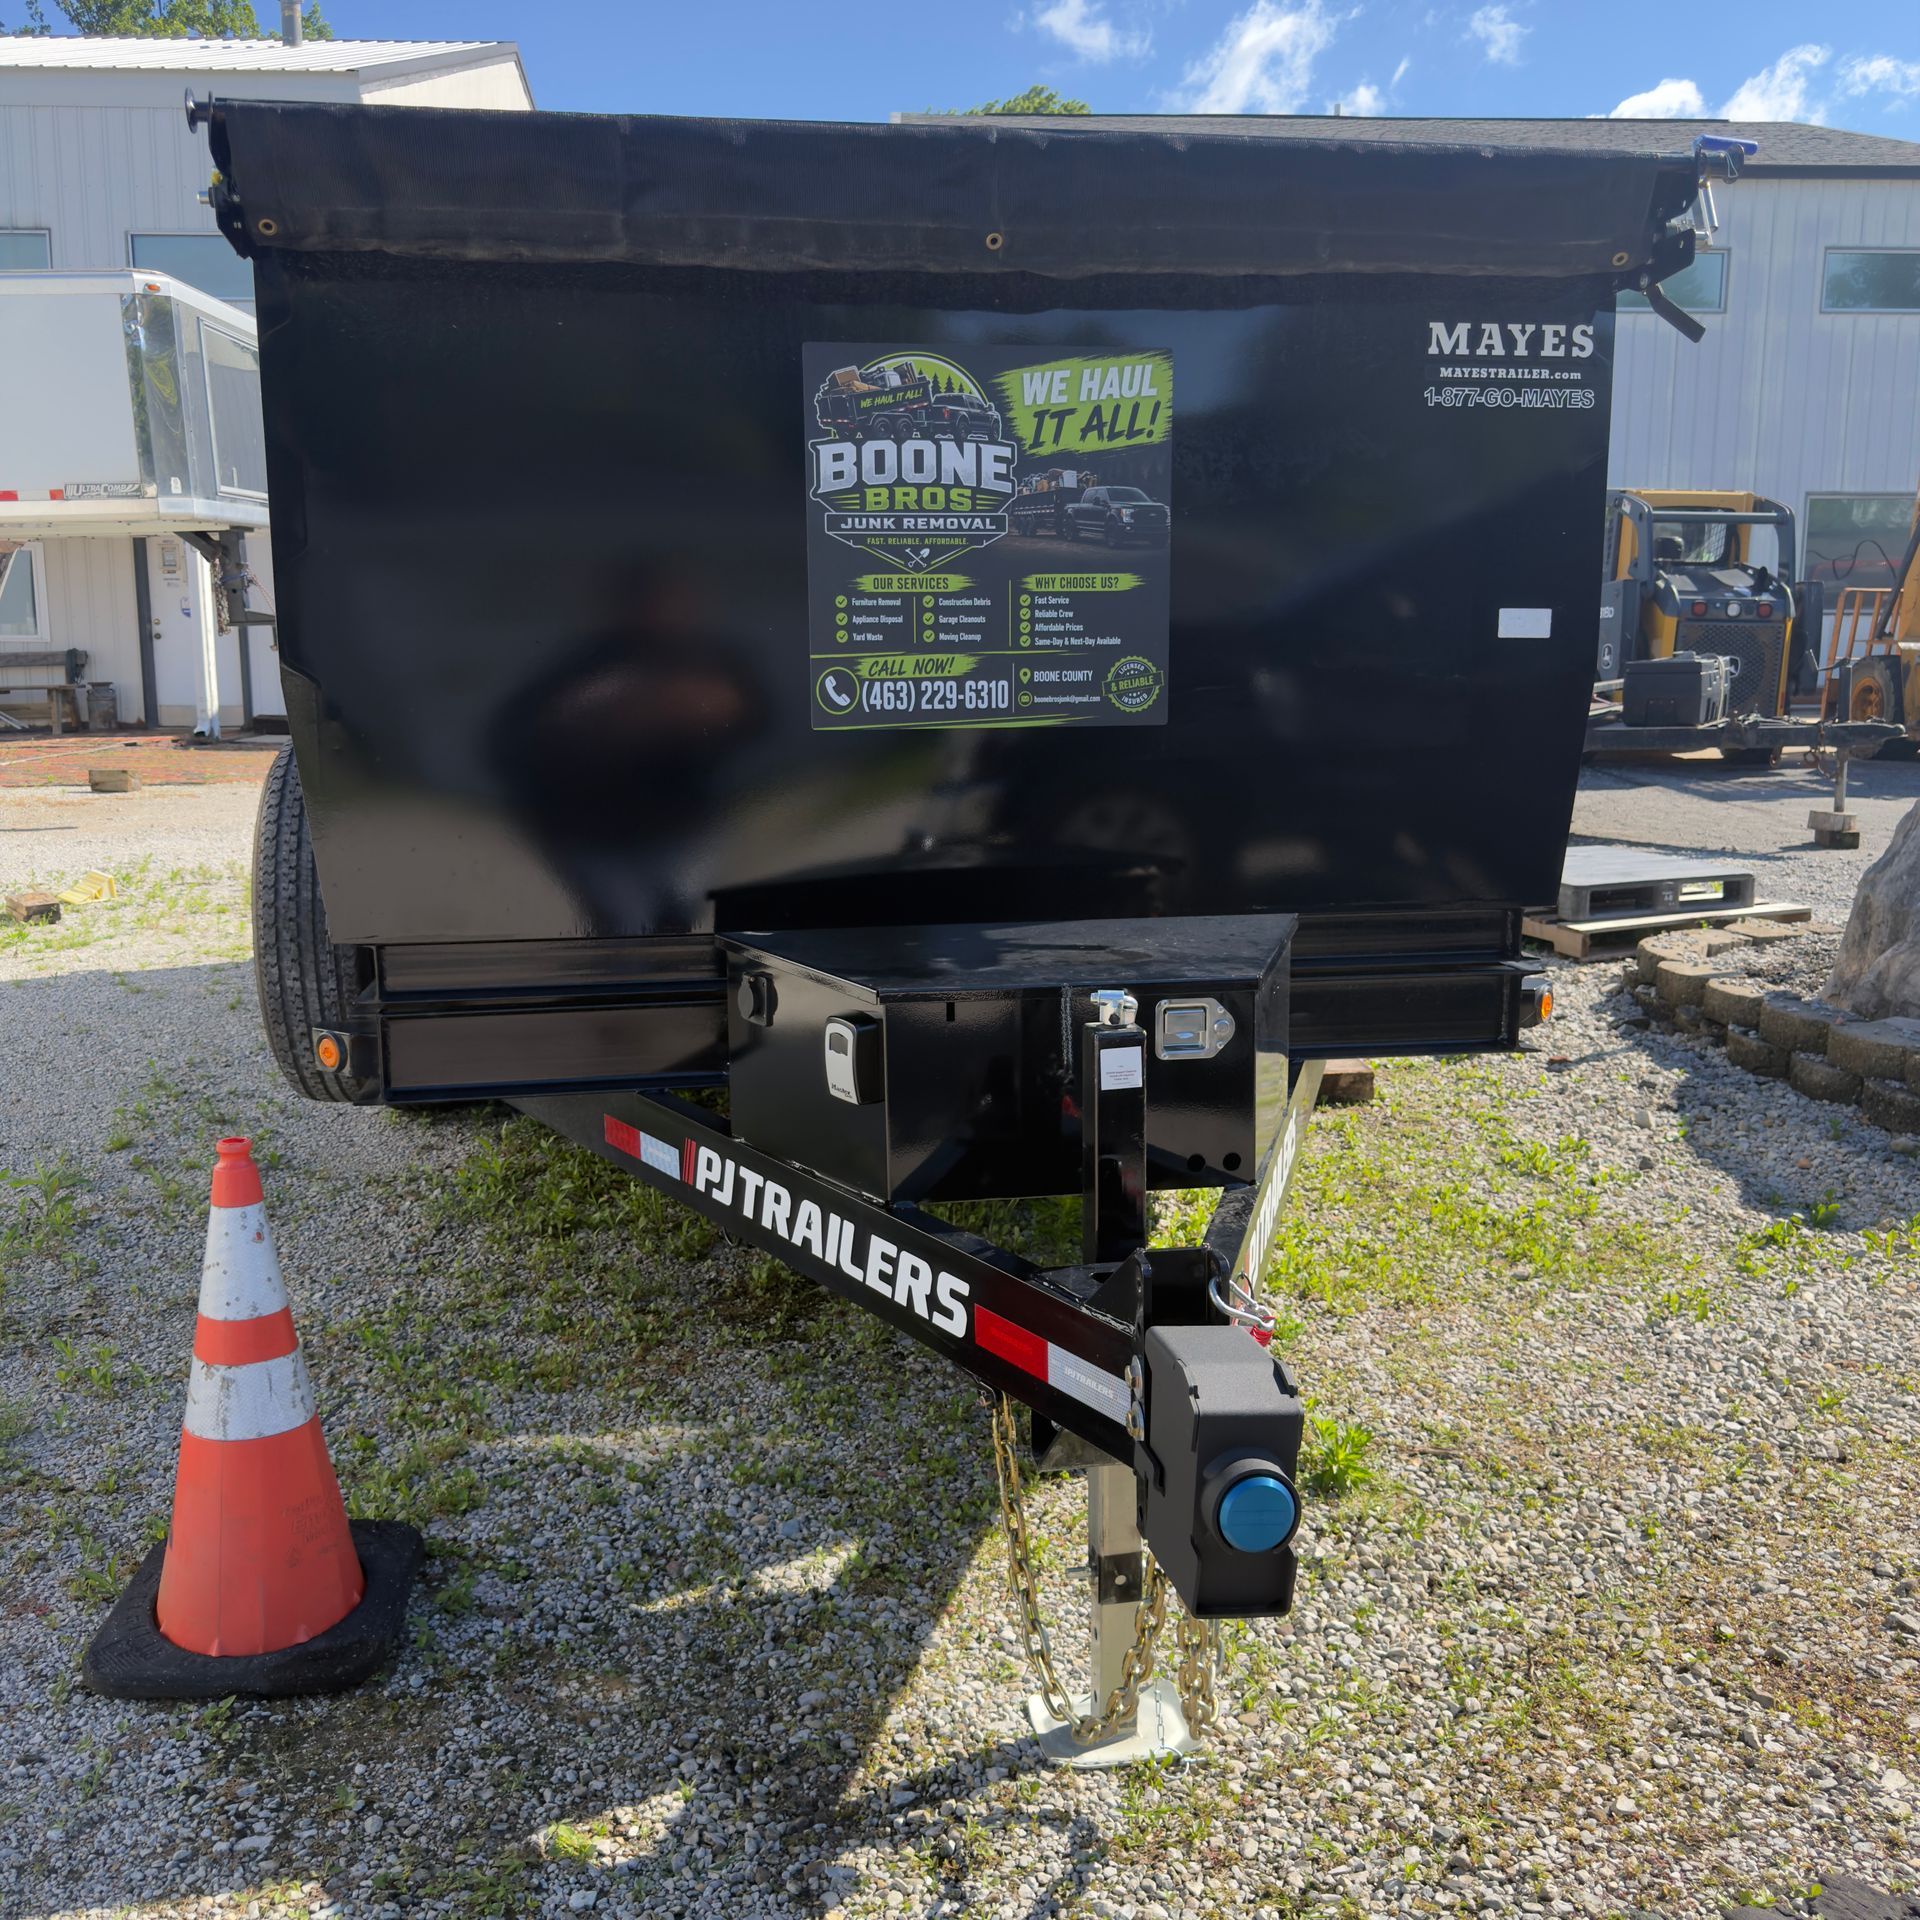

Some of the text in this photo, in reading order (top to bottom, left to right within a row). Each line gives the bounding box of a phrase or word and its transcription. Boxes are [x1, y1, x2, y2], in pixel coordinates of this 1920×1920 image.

[1427, 321, 1594, 358] MAYES
[1439, 367, 1582, 380] MAYESTRAILER.com
[1022, 364, 1158, 406] WE HAUL
[859, 389, 924, 409] WE HAUL IT ALL!
[1424, 386, 1595, 409] 1-877-GO-MAYES
[1028, 400, 1162, 450] IT ALL!
[816, 439, 1013, 494] BOONE
[863, 486, 973, 512] BROS
[840, 517, 997, 530] JUNK REMOVAL
[867, 537, 969, 545] FAST. RELIABLE. AFFORDABLE.
[873, 577, 949, 590] OUR SERVICES
[1035, 576, 1119, 589] WHY CHOOSE US?
[852, 598, 901, 606] Furniture Removal
[939, 598, 991, 606] Construction Debris
[1035, 596, 1069, 604] Fast Service
[852, 615, 903, 625] Appliance Disposal
[938, 615, 986, 625] Garage Cleanouts
[1035, 609, 1073, 618] Reliable Crew
[1035, 623, 1083, 632] Affordable Prices
[852, 632, 883, 641] Yard Waste
[939, 632, 982, 642] Moving Cleanup
[1035, 637, 1063, 647] Same-Day
[1070, 637, 1096, 647] Next-Day
[1096, 636, 1121, 645] Available
[868, 656, 956, 677] CALL NOW!
[1118, 663, 1145, 675] LICENSED
[1033, 670, 1093, 682] BOONE COUNTY
[1111, 675, 1154, 692] & RELIABLE
[861, 680, 1009, 713] (463) 229-6310
[1121, 693, 1148, 705] INSURED
[695, 1145, 970, 1339] PJ TRAILERS
